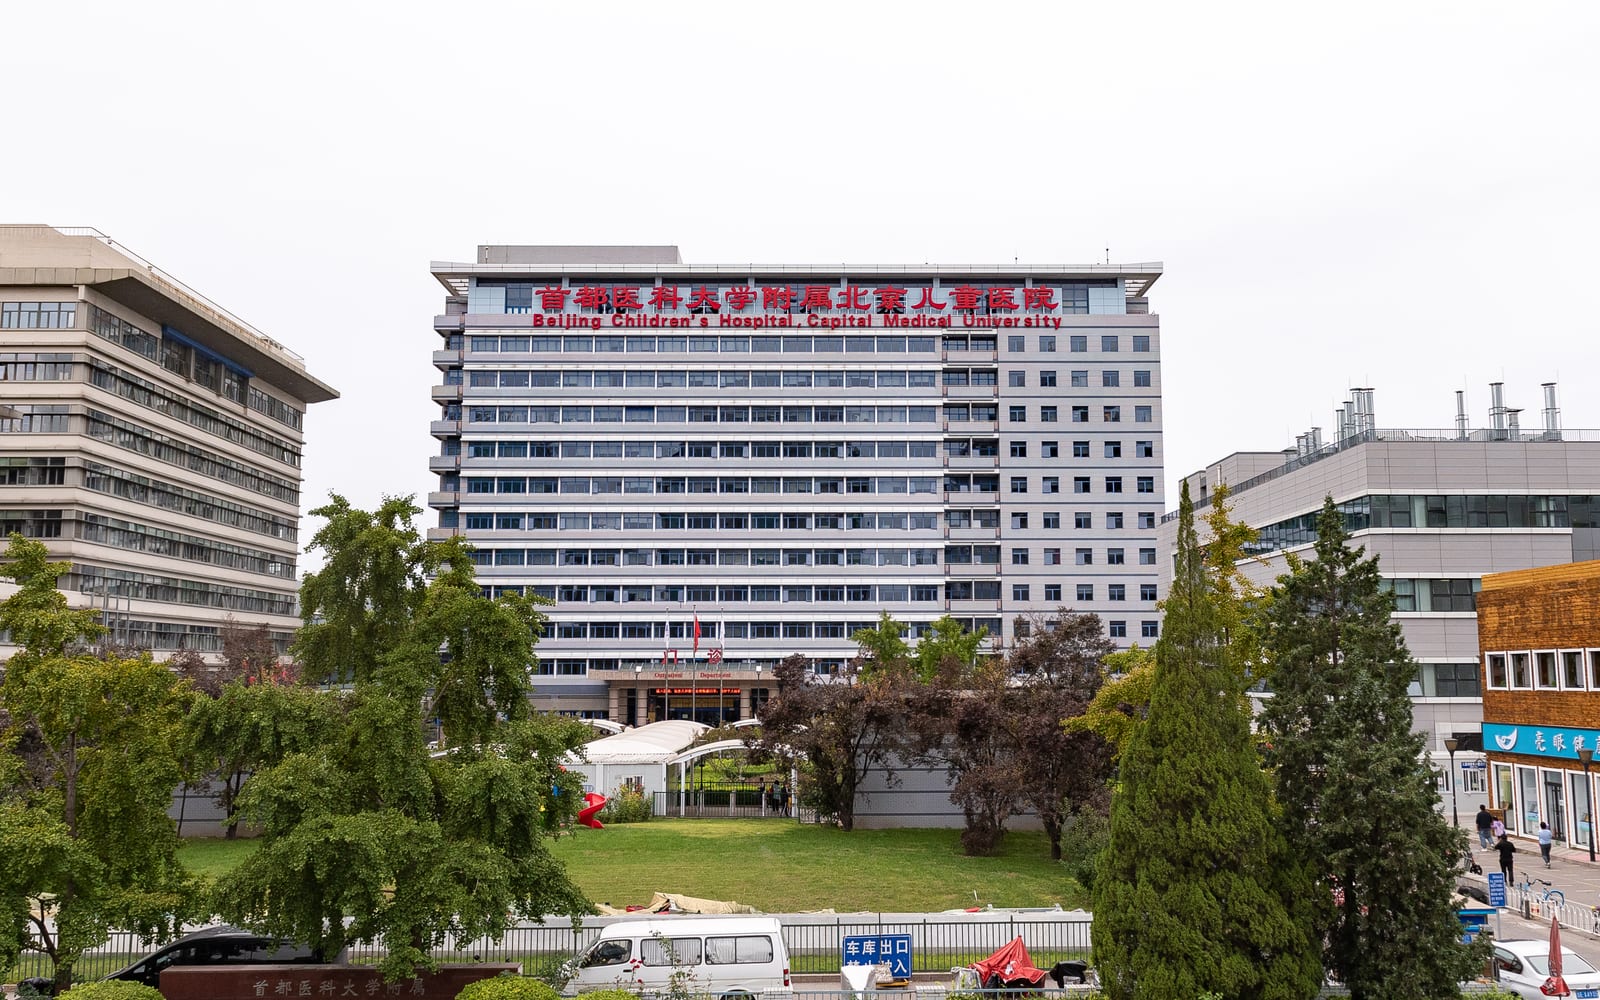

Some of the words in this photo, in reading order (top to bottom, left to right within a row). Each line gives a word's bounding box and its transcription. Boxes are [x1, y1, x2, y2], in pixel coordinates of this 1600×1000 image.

[535, 285, 1060, 311] 首都医科大学附属北京儿童医院
[533, 313, 601, 330] Beijing
[611, 313, 709, 328] Children's
[807, 313, 872, 330] Capital
[883, 313, 951, 328] Medical
[963, 313, 1062, 330] University
[846, 940, 908, 956] 车库出口
[252, 978, 426, 997] 首都医科大学附属
